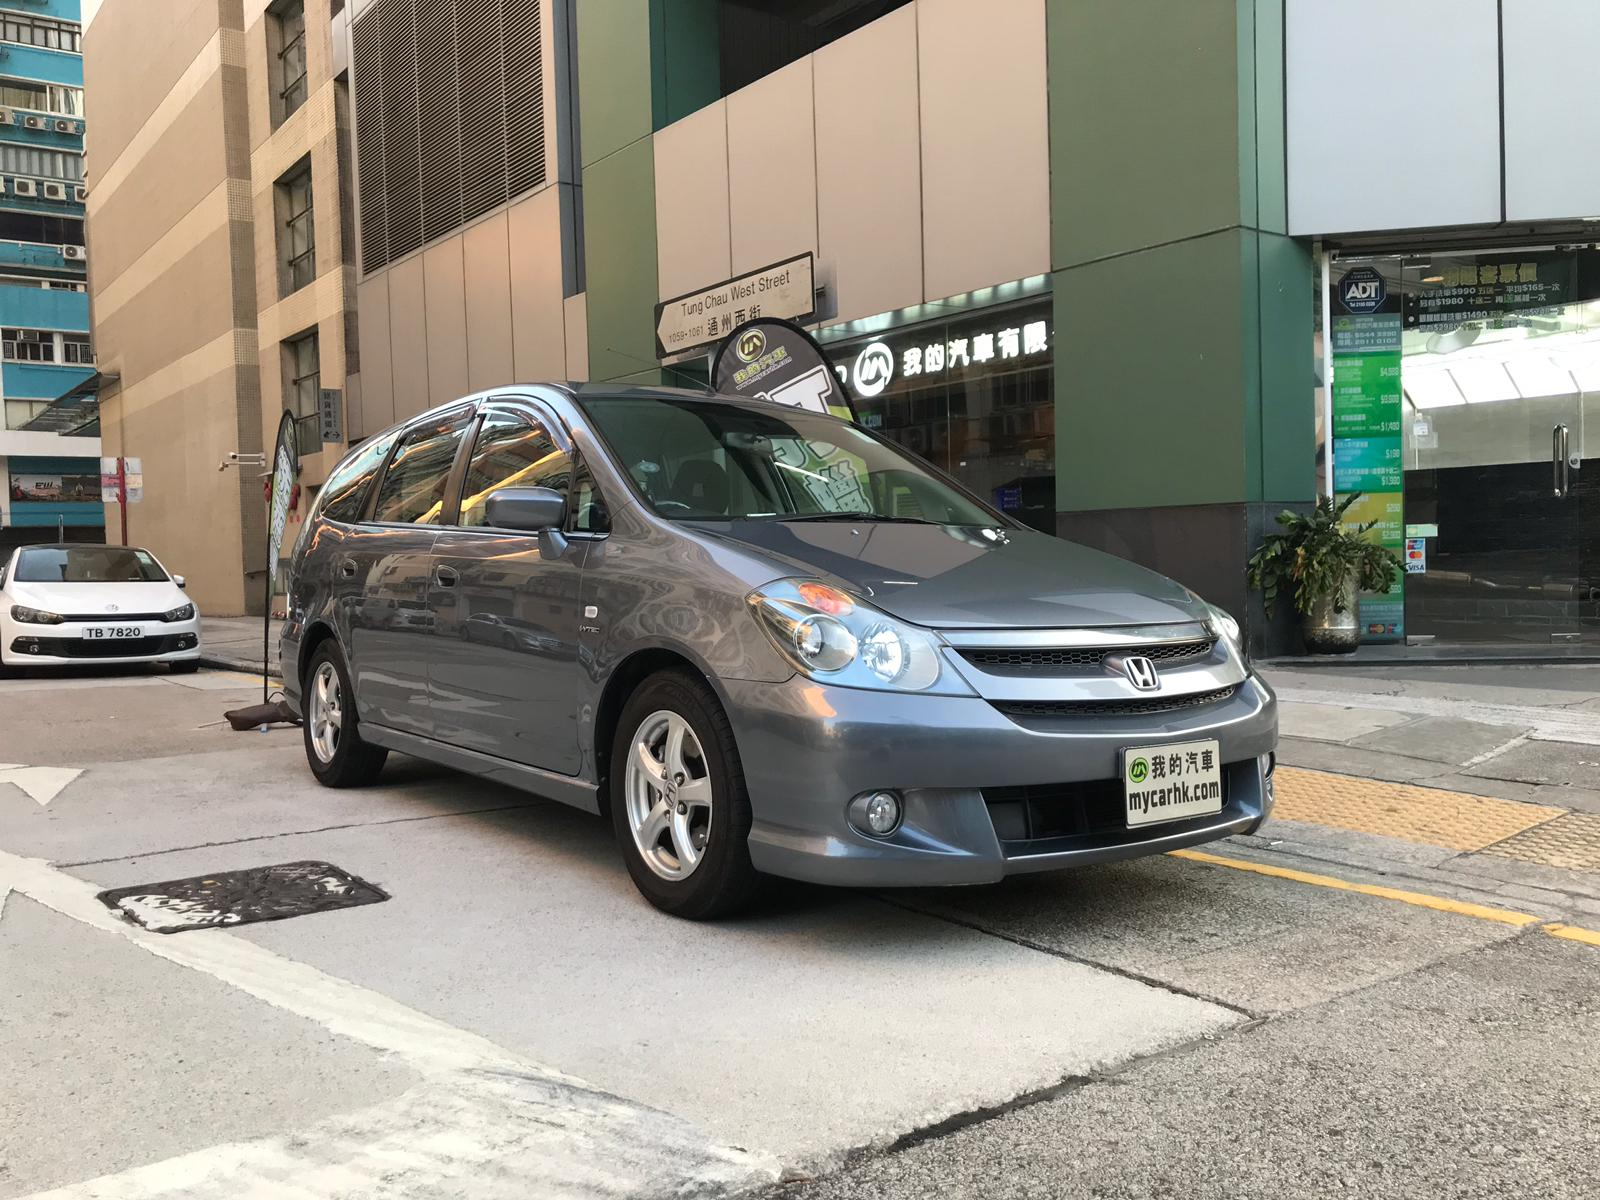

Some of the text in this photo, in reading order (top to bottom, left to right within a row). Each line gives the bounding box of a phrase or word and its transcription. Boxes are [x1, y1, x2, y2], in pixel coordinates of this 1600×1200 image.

[681, 269, 790, 317] Tung Chau West Street
[1346, 282, 1379, 299] ADT
[903, 320, 1055, 377] 我的汽車有限
[86, 627, 141, 638] TB 7820
[1151, 749, 1214, 779] 我的汽車
[1129, 780, 1219, 814] mycarhk.com
